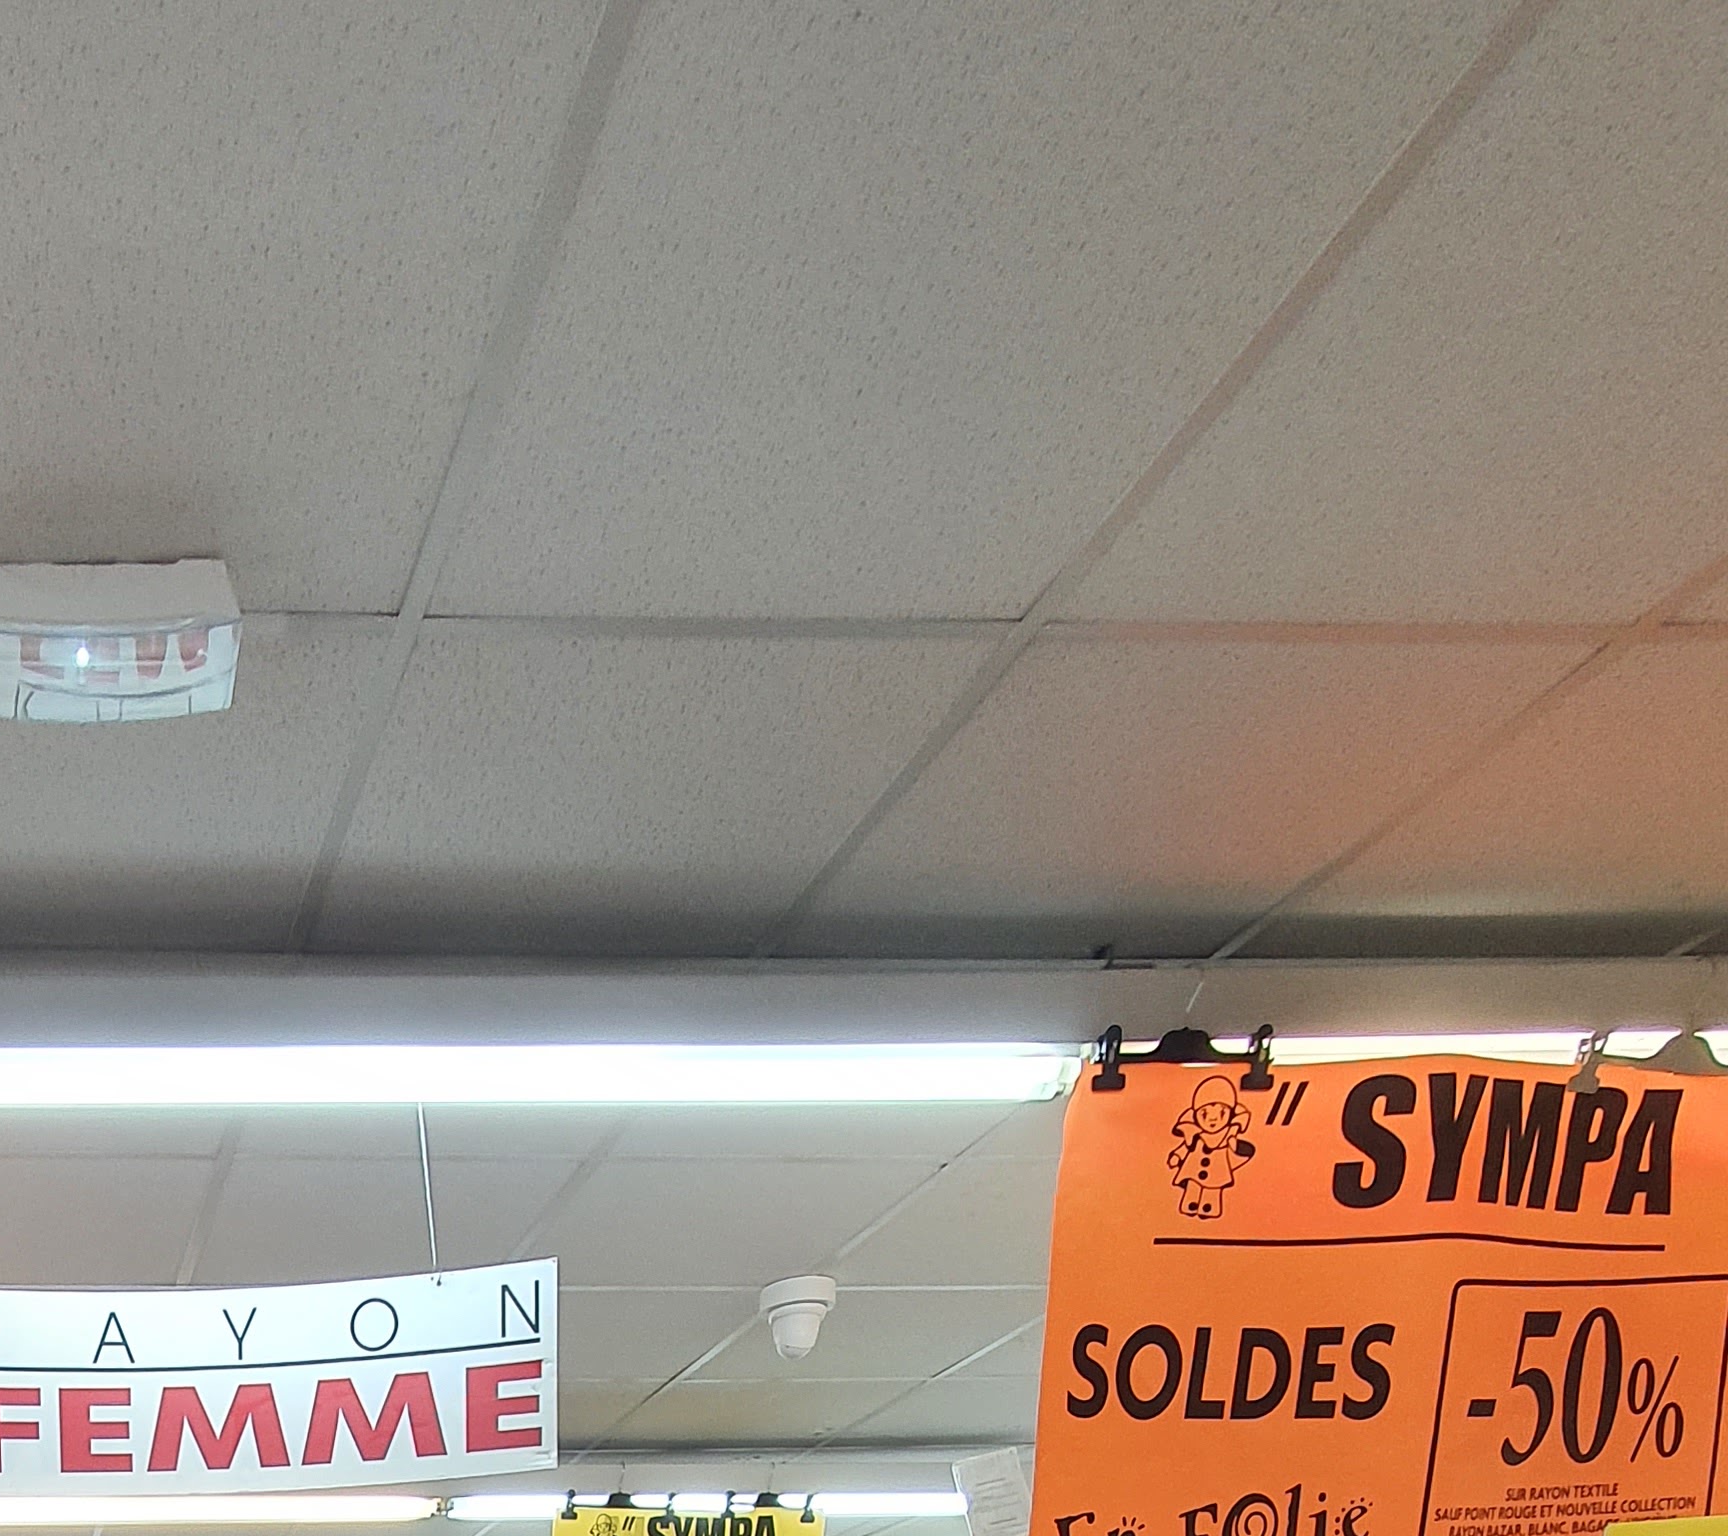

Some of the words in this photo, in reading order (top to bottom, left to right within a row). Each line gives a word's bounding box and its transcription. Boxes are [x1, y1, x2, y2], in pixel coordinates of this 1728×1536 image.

[1332, 1072, 1684, 1216] SYMPA
[1066, 1323, 1395, 1421] SOLDES
[1467, 1307, 1684, 1466] -50%
[1434, 1507, 1463, 1522] SAUF
[1464, 1505, 1498, 1521] POINT
[1498, 1504, 1538, 1519] ROUGE
[1540, 1503, 1554, 1518] ET
[1556, 1500, 1617, 1517] NOUVELLE
[1620, 1495, 1696, 1512] COLLECTION
[1505, 1487, 1526, 1502] SUR
[1528, 1486, 1569, 1500] RAYON
[1572, 1483, 1619, 1498] TEXTILE
